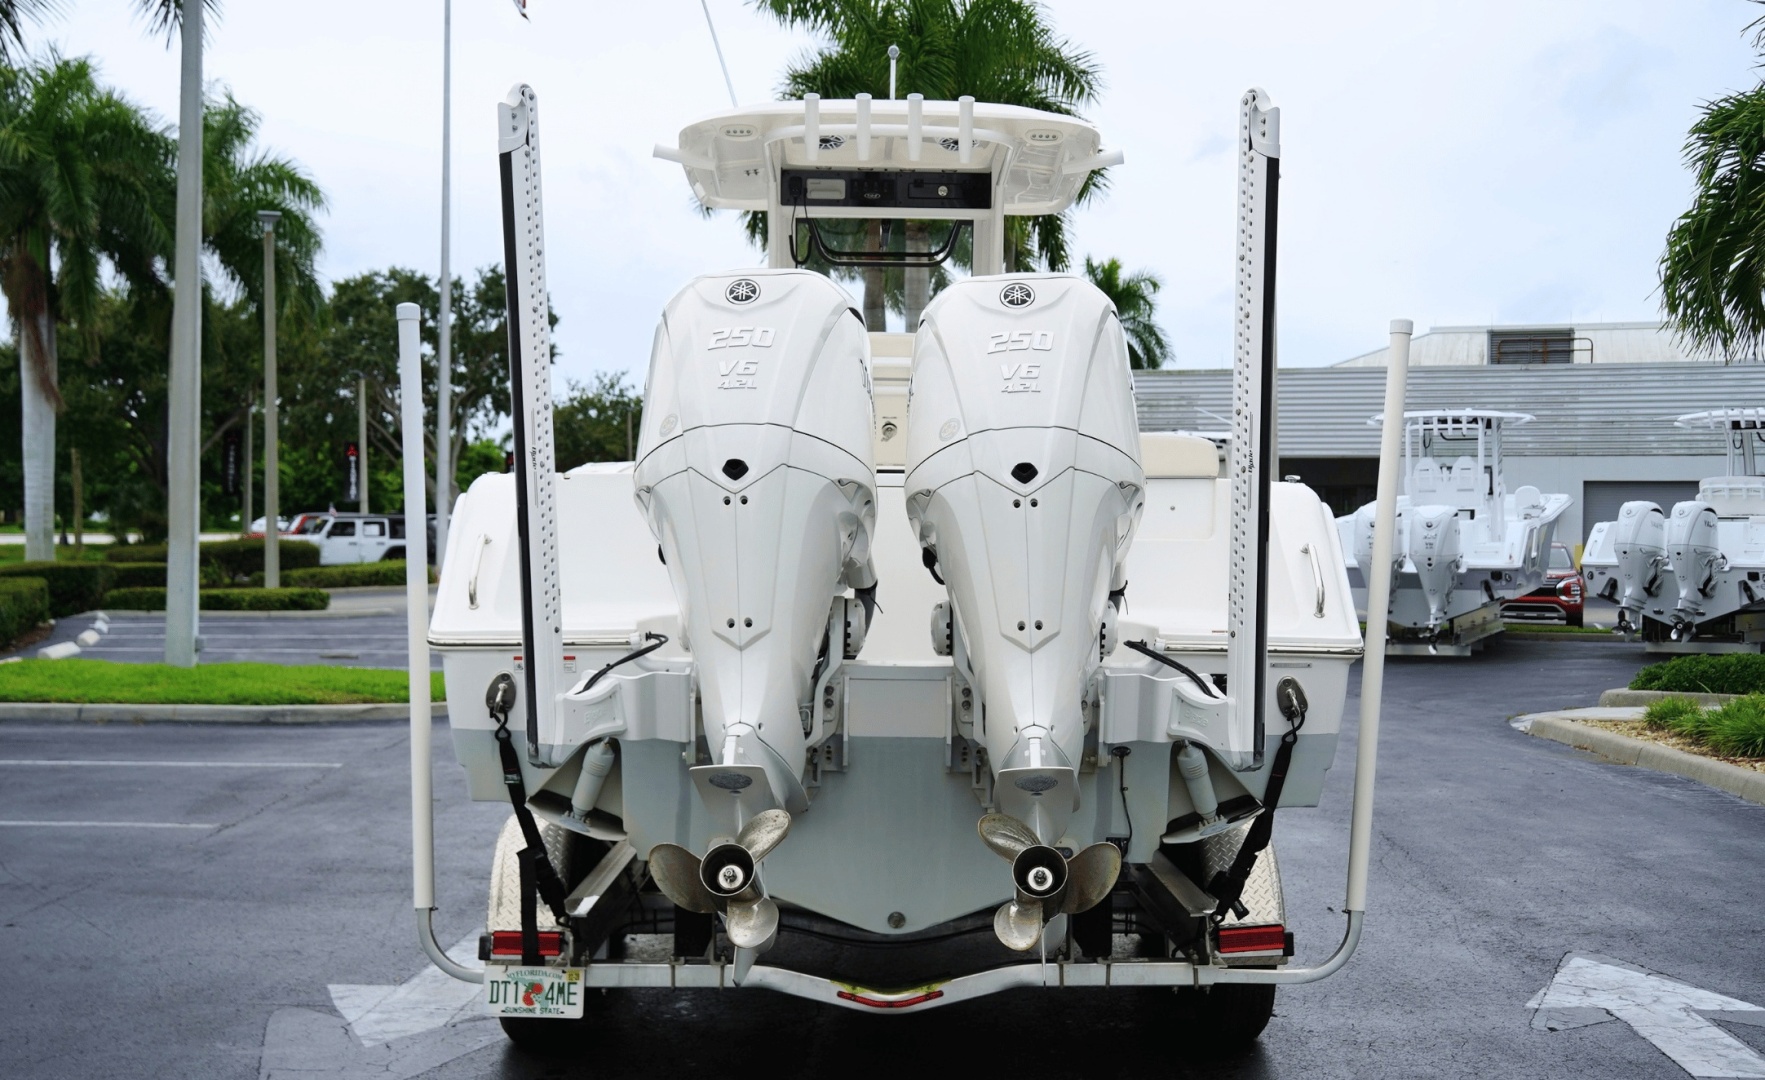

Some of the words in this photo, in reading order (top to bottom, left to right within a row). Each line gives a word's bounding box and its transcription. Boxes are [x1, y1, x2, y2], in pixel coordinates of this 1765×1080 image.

[707, 326, 776, 351] 250
[987, 329, 1055, 355] 250
[718, 359, 759, 377] V6
[1000, 362, 1041, 381] V6
[717, 378, 758, 390] 4.2L
[1000, 382, 1041, 394] 4.2L
[506, 969, 563, 980] MYFLORIDA.COM
[489, 980, 519, 1004] DT1
[545, 981, 578, 1005] 4ME
[505, 1006, 537, 1014] SUNSHINE
[540, 1007, 560, 1015] STATE
